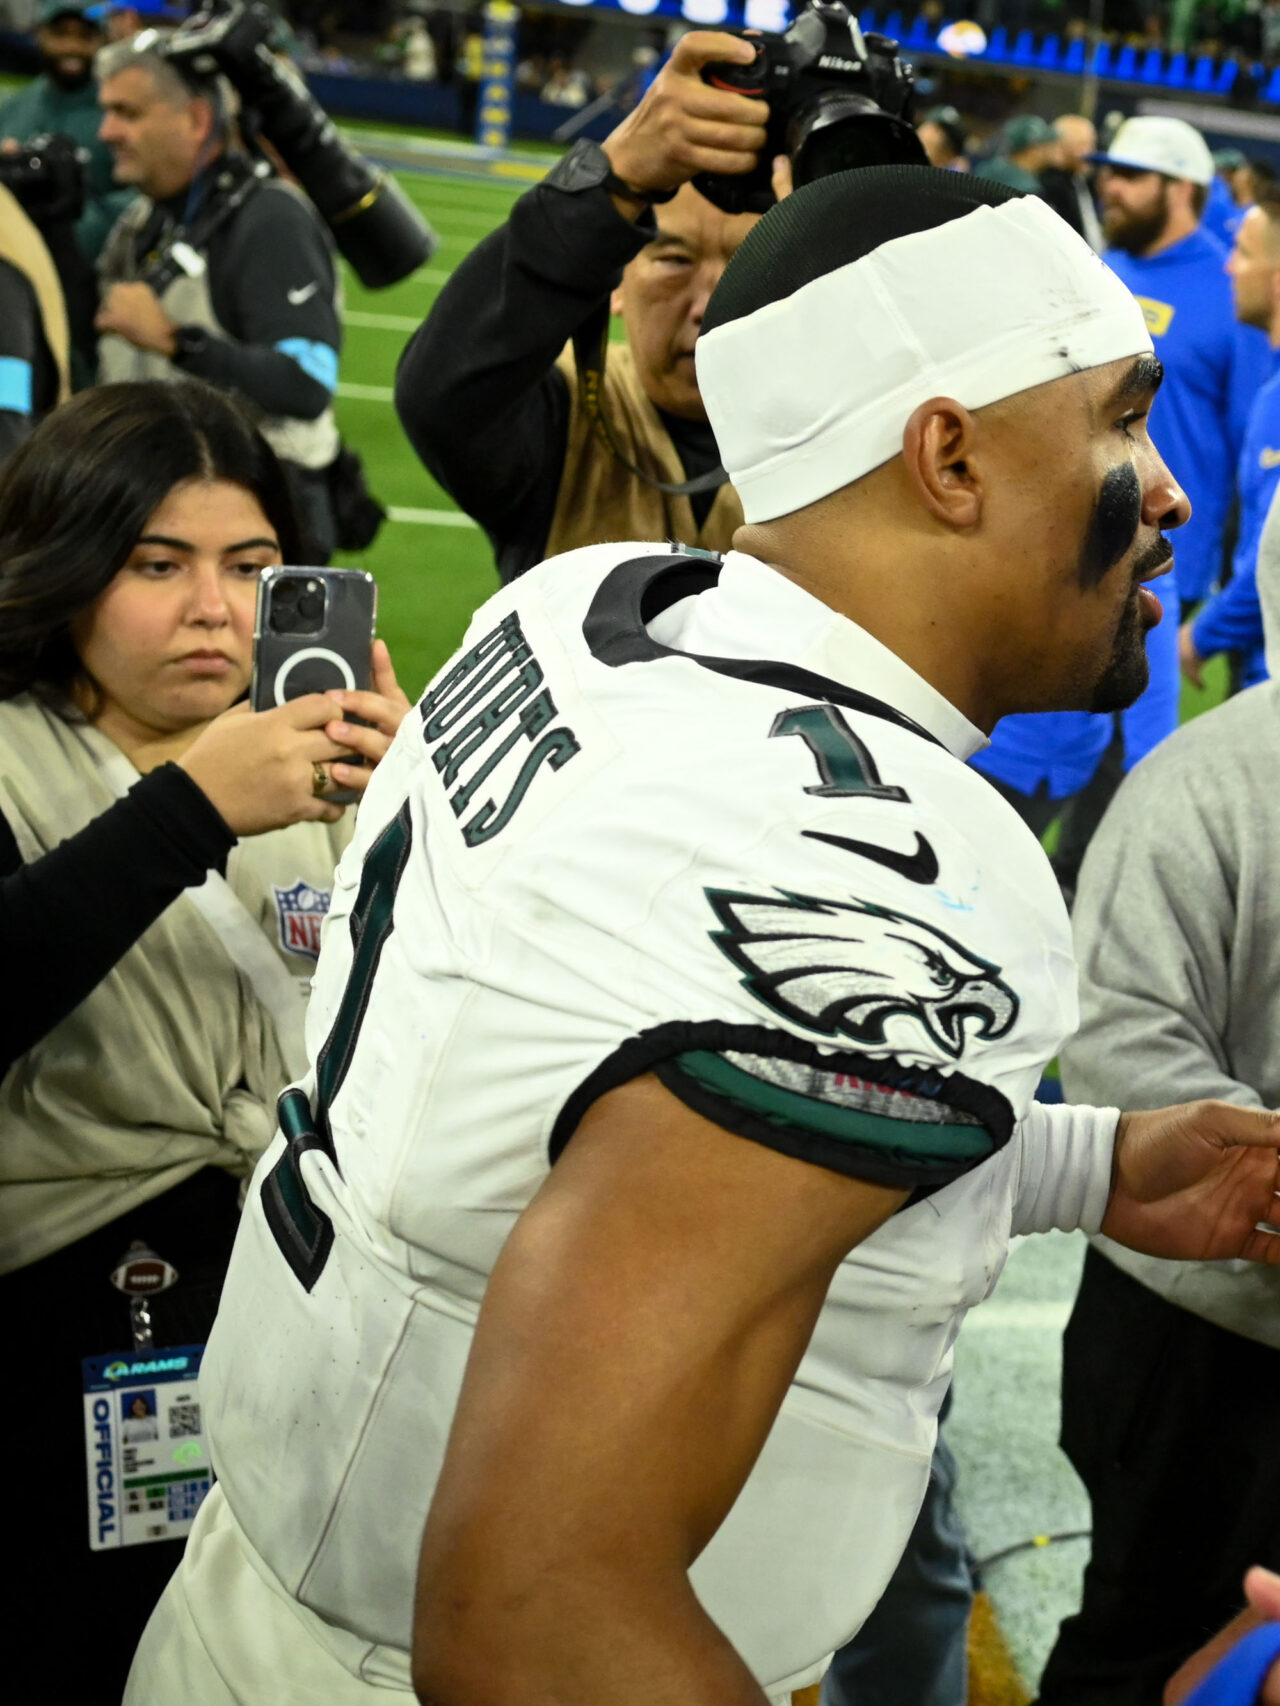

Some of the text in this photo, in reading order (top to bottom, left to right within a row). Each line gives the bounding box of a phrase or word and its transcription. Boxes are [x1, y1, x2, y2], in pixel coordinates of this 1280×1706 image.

[818, 54, 862, 72] Nikon
[420, 609, 582, 848] HURTS
[767, 704, 912, 804] 1
[287, 914, 323, 953] NF
[130, 1356, 189, 1376] RAMS
[93, 1399, 115, 1544] OFFICIAL
